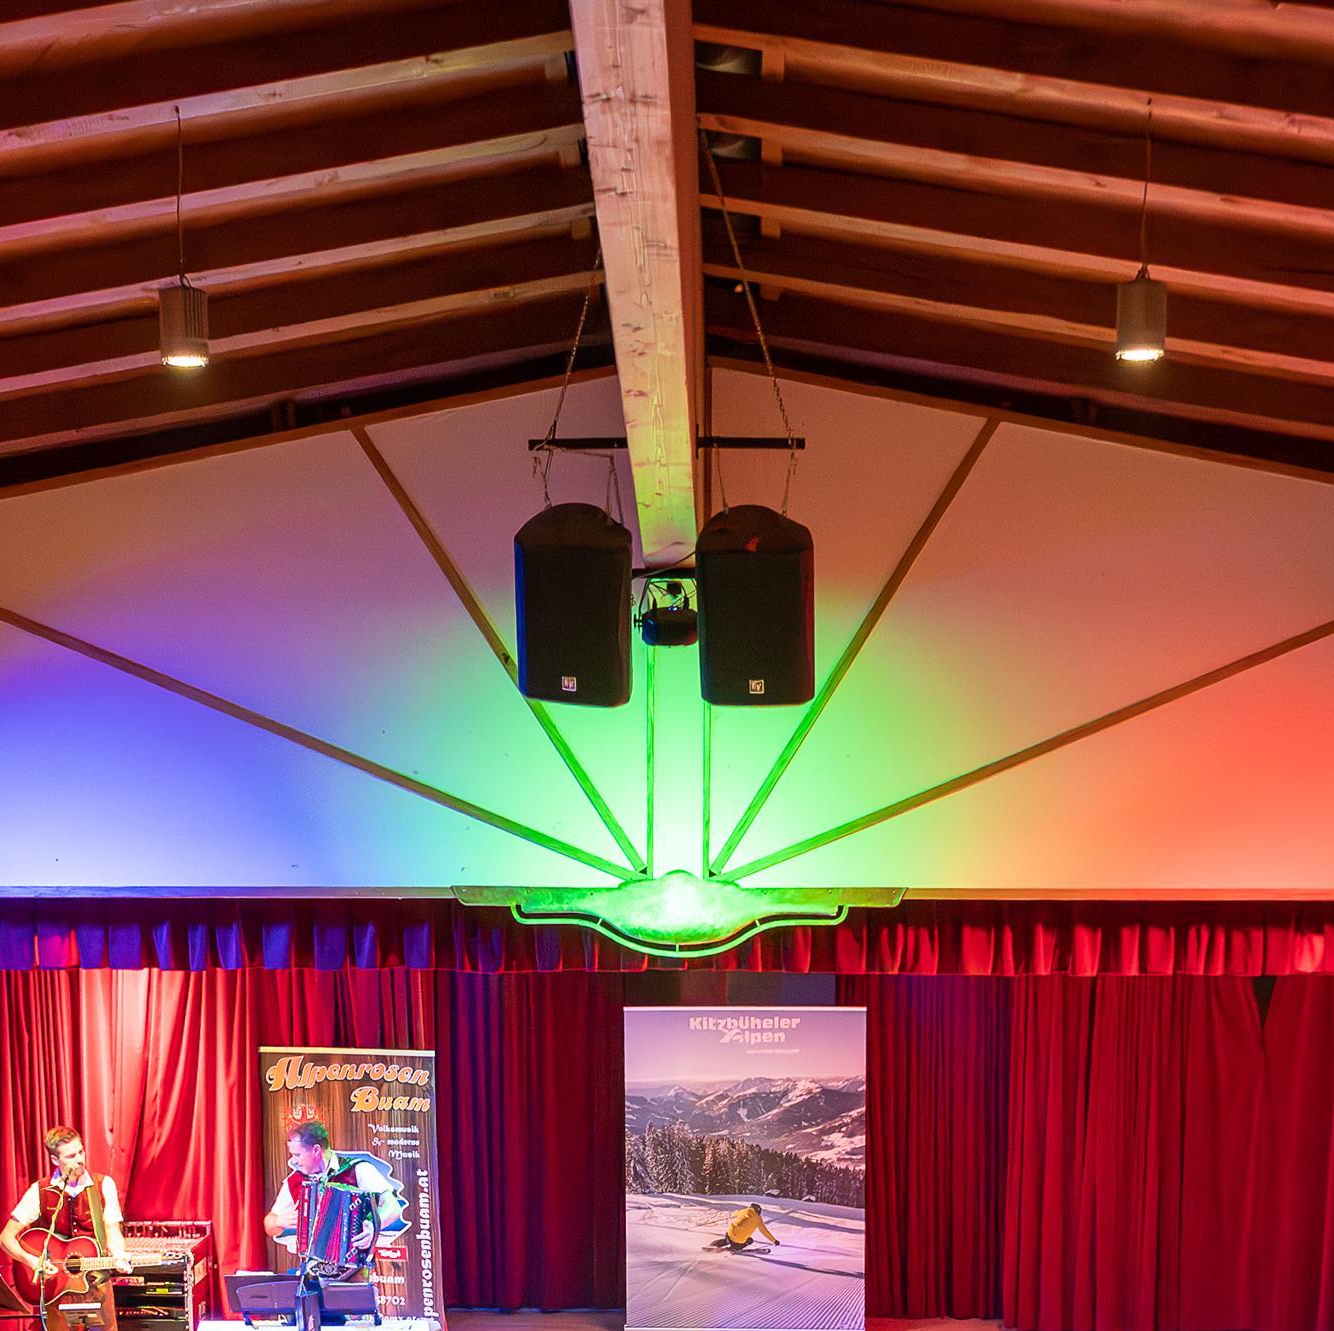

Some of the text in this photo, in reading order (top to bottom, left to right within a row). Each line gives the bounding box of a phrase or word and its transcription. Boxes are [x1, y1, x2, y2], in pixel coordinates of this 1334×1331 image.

[689, 1016, 801, 1032] Kitzbüheler
[719, 1028, 786, 1045] Alpen
[266, 1055, 430, 1092] Alpenrosen
[350, 1086, 431, 1112] Buam
